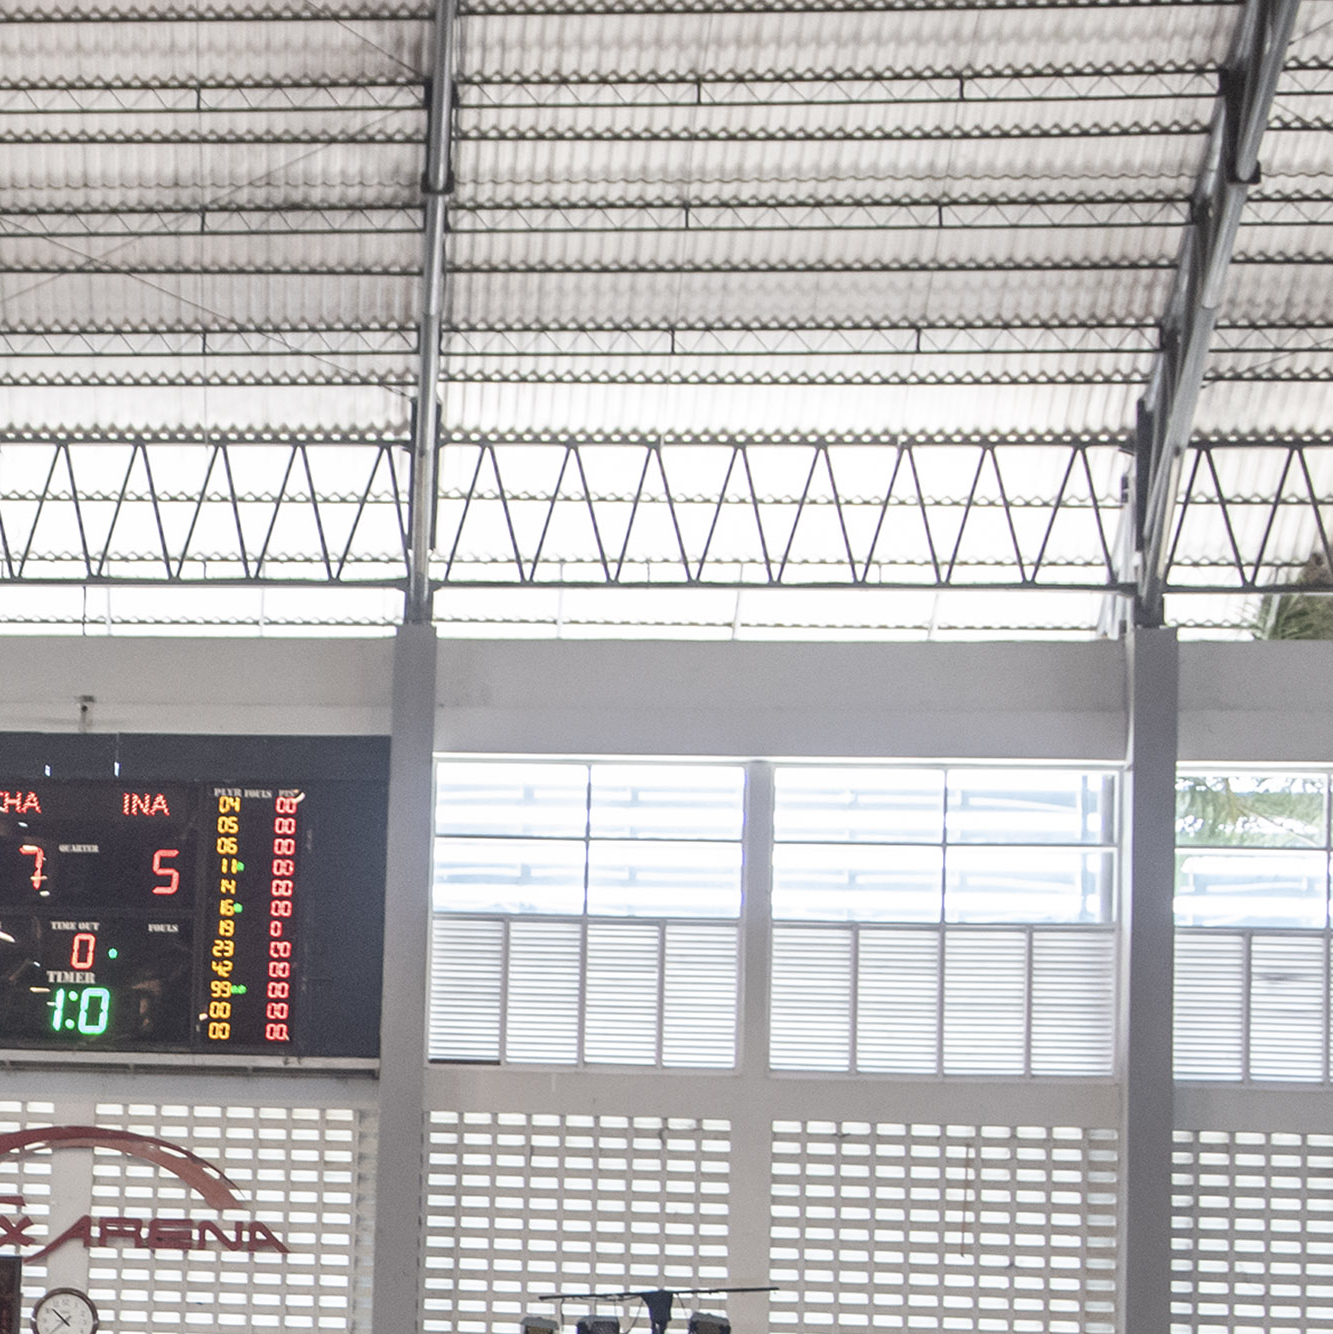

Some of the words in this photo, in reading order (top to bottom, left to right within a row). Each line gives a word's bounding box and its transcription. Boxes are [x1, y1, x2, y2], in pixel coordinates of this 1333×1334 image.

[123, 793, 170, 816] INA
[219, 796, 241, 813] 04
[275, 796, 297, 814] 00
[217, 816, 239, 834] 05
[274, 817, 296, 835] 00
[59, 844, 99, 852] QUARTER
[216, 837, 238, 855] 06
[273, 838, 295, 856] 00
[20, 845, 44, 889] 7
[152, 849, 180, 895] 5
[221, 857, 238, 874] 11
[272, 858, 294, 876] 00
[271, 879, 293, 897] 00
[270, 900, 292, 918] 00
[51, 921, 74, 930] TIME
[78, 922, 100, 931] OUT
[148, 923, 179, 932] FOULS
[71, 933, 96, 969] 0
[212, 939, 235, 958] 23
[46, 971, 96, 983] TIMER
[210, 980, 232, 998] 99
[267, 982, 290, 999] 00
[209, 1001, 231, 1019] 00
[266, 1002, 289, 1020] 00
[208, 1022, 230, 1039] 00
[265, 1023, 288, 1040] 00
[23, 1214, 290, 1264] ARENA
